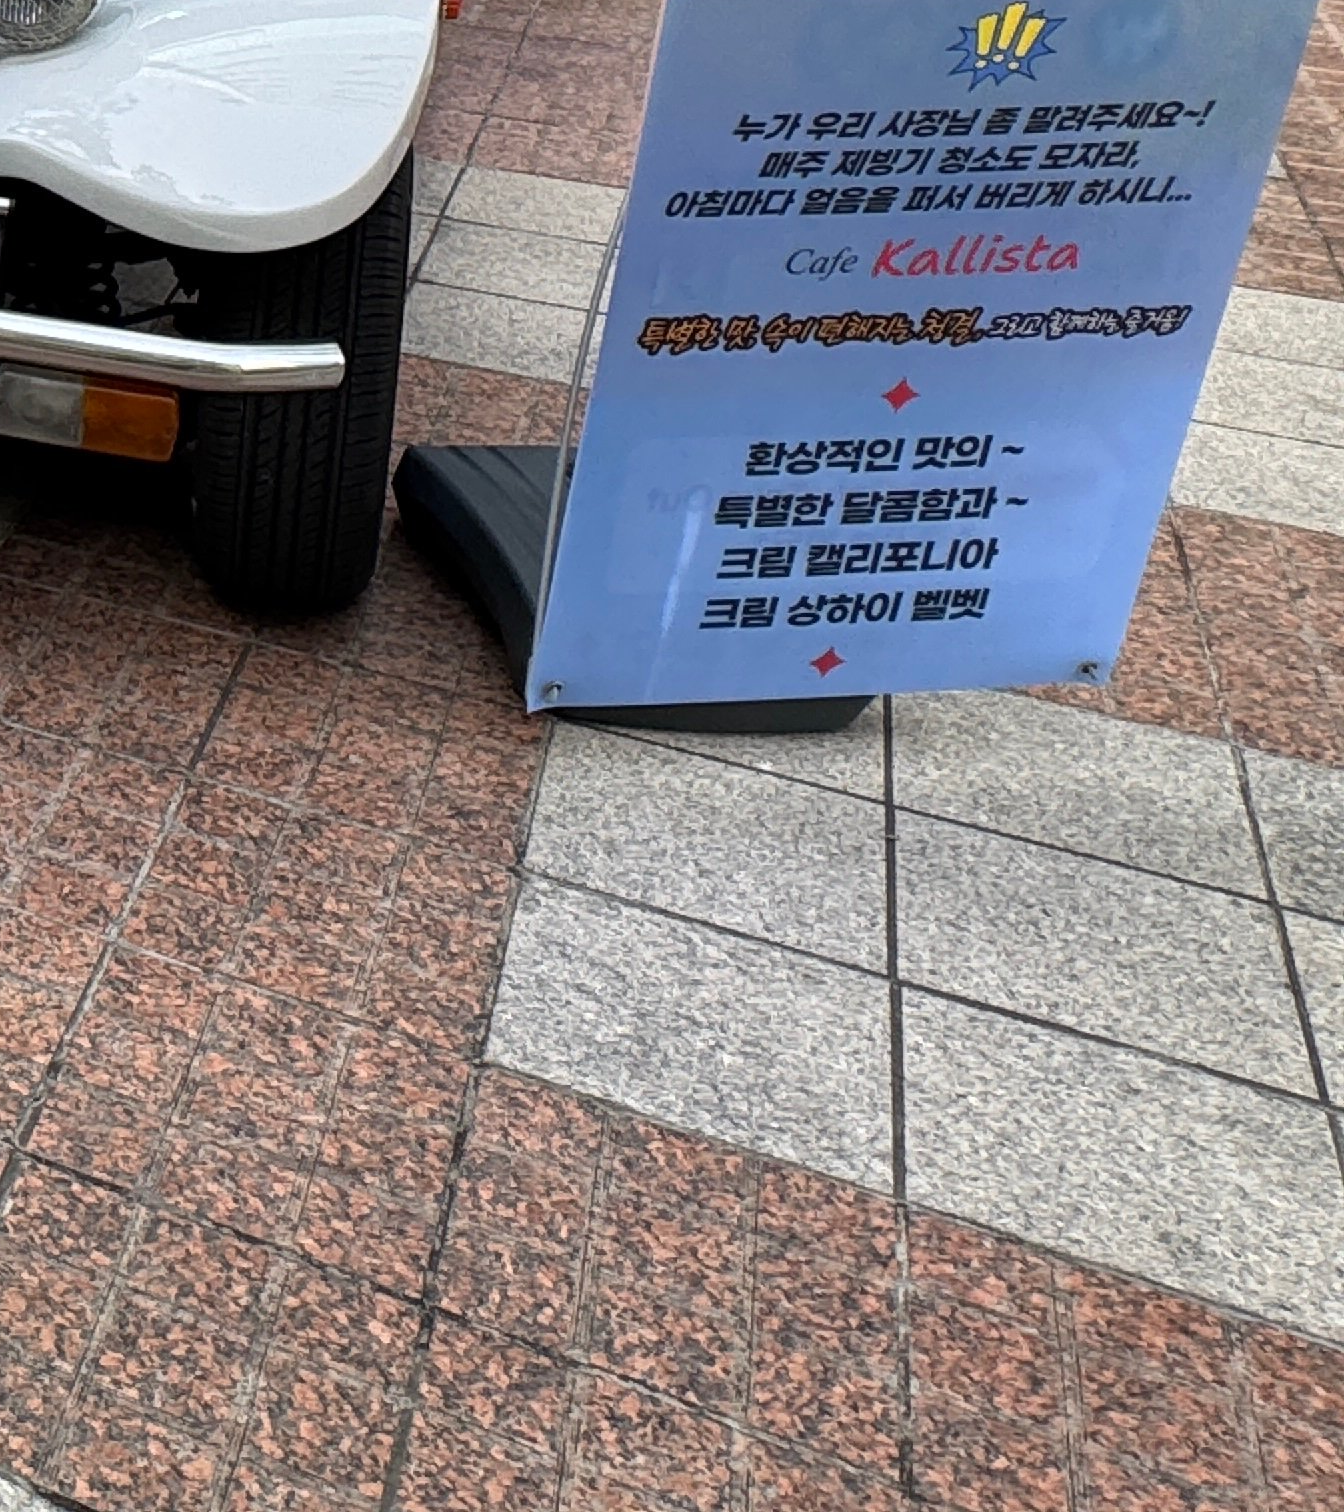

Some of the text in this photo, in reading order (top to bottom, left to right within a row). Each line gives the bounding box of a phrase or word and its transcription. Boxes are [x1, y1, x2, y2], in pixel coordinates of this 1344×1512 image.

[732, 110, 803, 144] 누가
[805, 110, 879, 142] 우리
[879, 106, 981, 141] 사장님
[982, 105, 1017, 138] 좀
[758, 140, 1144, 181] 매주 제빙기 청소도 모자라,
[664, 188, 796, 221] 아침마다
[798, 185, 900, 217] 얼음을
[903, 182, 973, 211] 퍼서
[975, 179, 1072, 209] 버리게
[784, 232, 1081, 282] Cafe Kallista
[744, 437, 906, 476] 환상적인
[911, 433, 995, 472] 맛의
[714, 493, 834, 529] 특별한
[838, 486, 999, 526] 달콤함과
[714, 537, 999, 581] 크림 캘리포니아
[698, 587, 993, 631] 크림 상하이 벨벳
